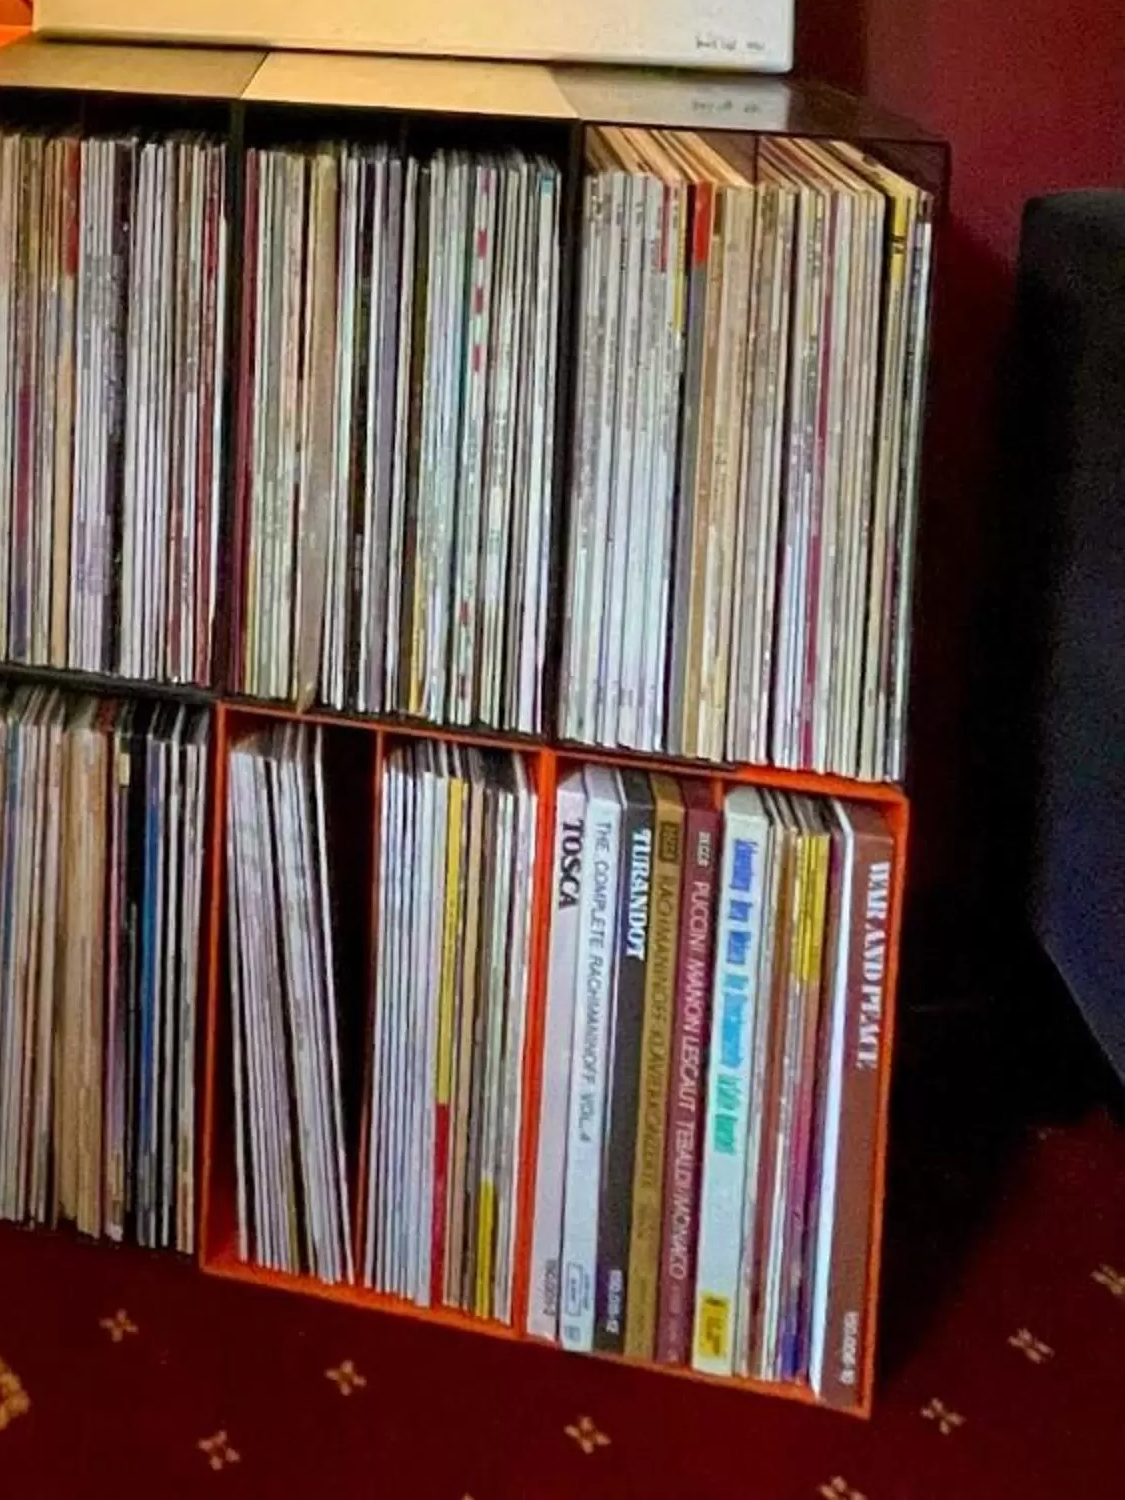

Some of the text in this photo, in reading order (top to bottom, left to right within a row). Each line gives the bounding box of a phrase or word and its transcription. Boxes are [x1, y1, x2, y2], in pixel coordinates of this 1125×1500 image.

[559, 818, 584, 910] TOSCA
[595, 821, 612, 853] THE
[589, 860, 610, 948] COMPLETE
[626, 829, 651, 960] TURANDOT
[687, 881, 711, 953] PUCCINI
[683, 956, 707, 1032] MANON
[856, 861, 890, 1070] WAR AND PEACE
[581, 955, 604, 1084] RACHMANINOFF
[679, 1035, 701, 1113] LESCAUT
